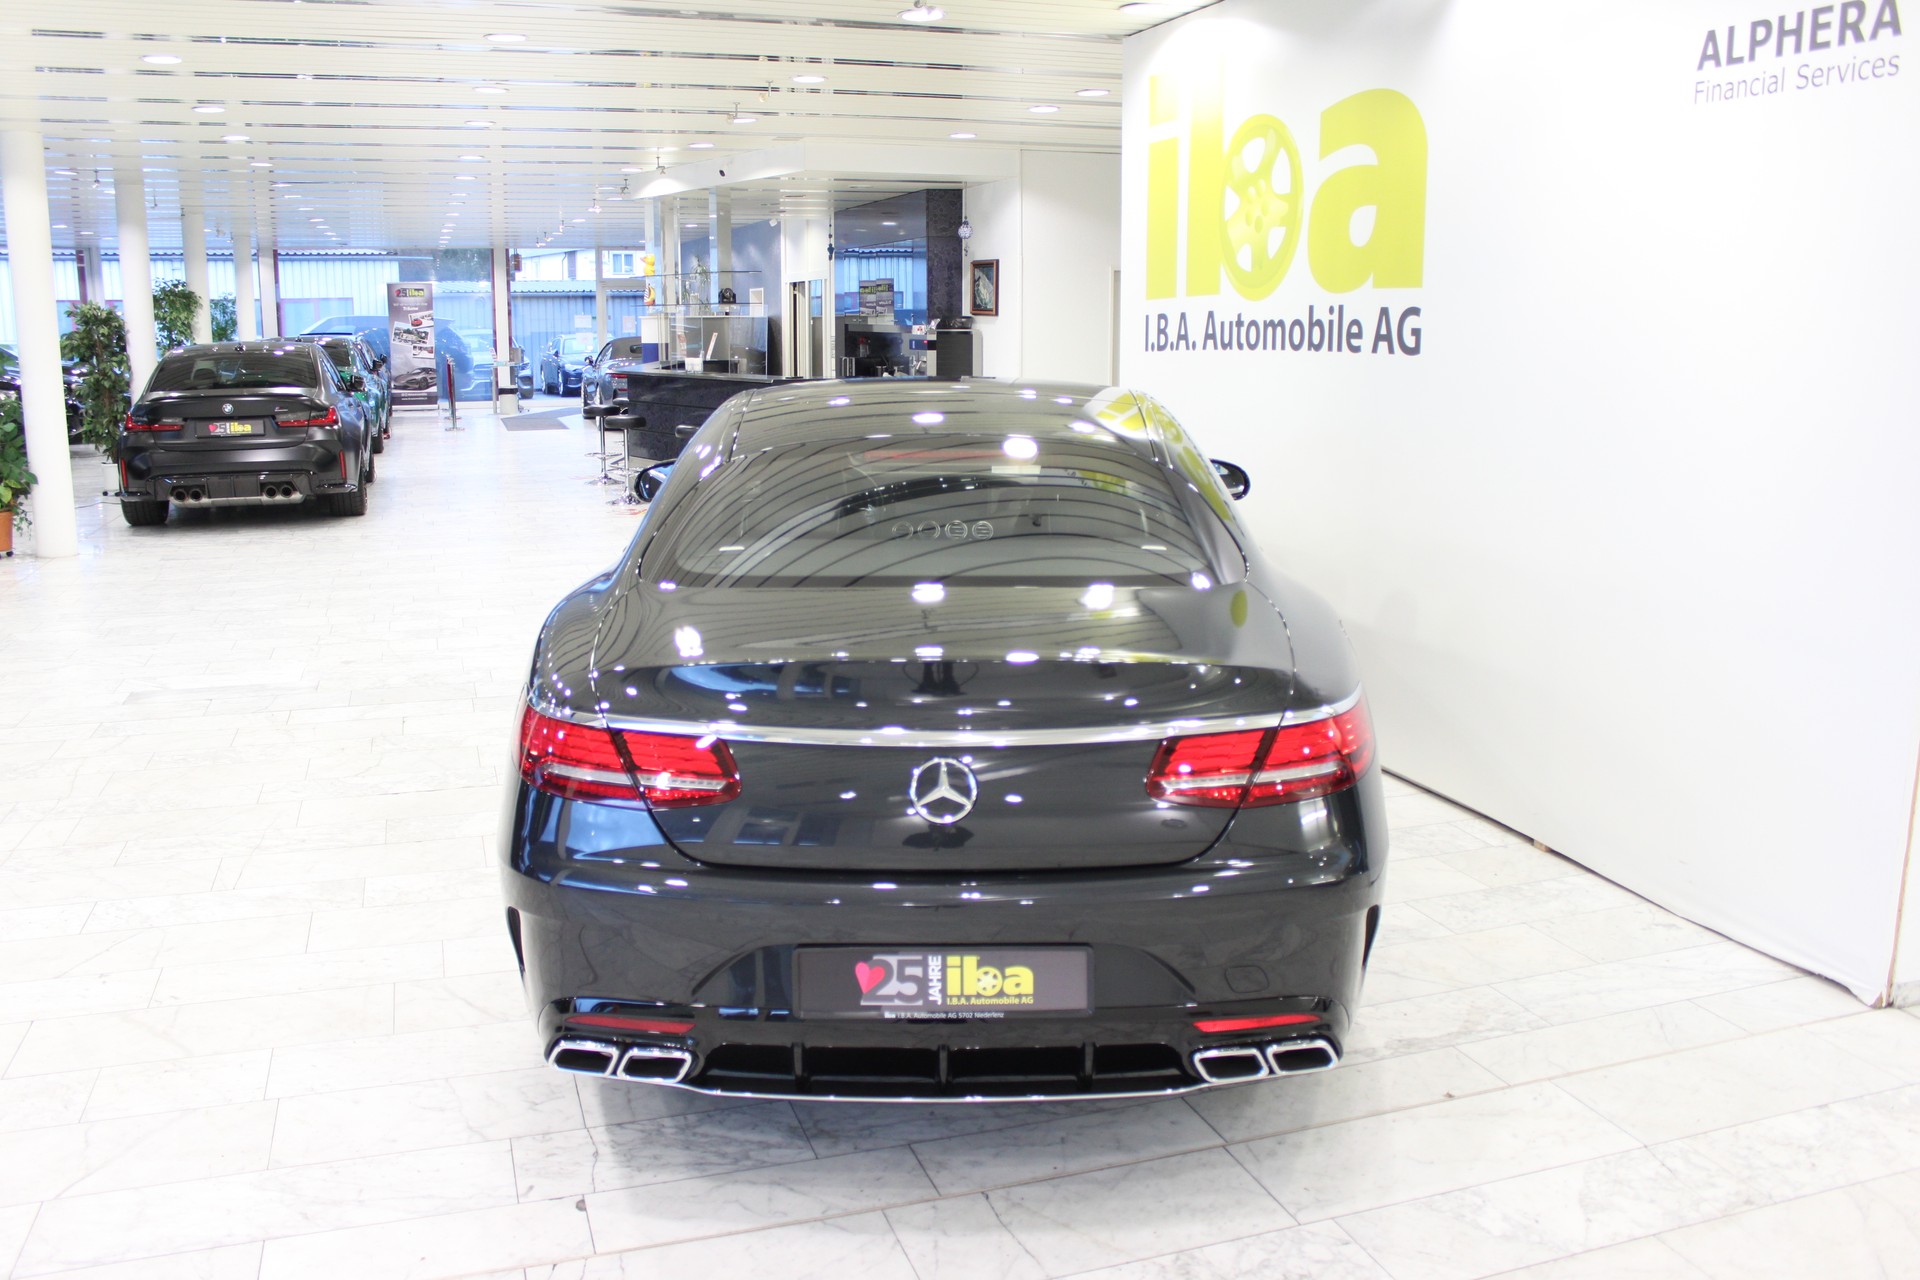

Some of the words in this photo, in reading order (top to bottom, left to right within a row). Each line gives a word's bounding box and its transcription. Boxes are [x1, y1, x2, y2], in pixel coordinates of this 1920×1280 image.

[1696, 0, 1902, 72] ALPHERA
[1694, 66, 1786, 104] Financial
[1796, 54, 1900, 90] Services
[1146, 62, 1429, 302] iba
[1144, 311, 1197, 353] I.B.A.
[1202, 304, 1364, 354] Automobile
[1371, 305, 1423, 357] AG
[230, 421, 252, 432] iba
[860, 954, 923, 1006] 25
[928, 955, 942, 1006] JAHRE
[946, 955, 1034, 997] iba
[946, 996, 969, 1006] I.B.A.
[971, 996, 1019, 1006] Automobile
[1021, 996, 1034, 1005] AG
